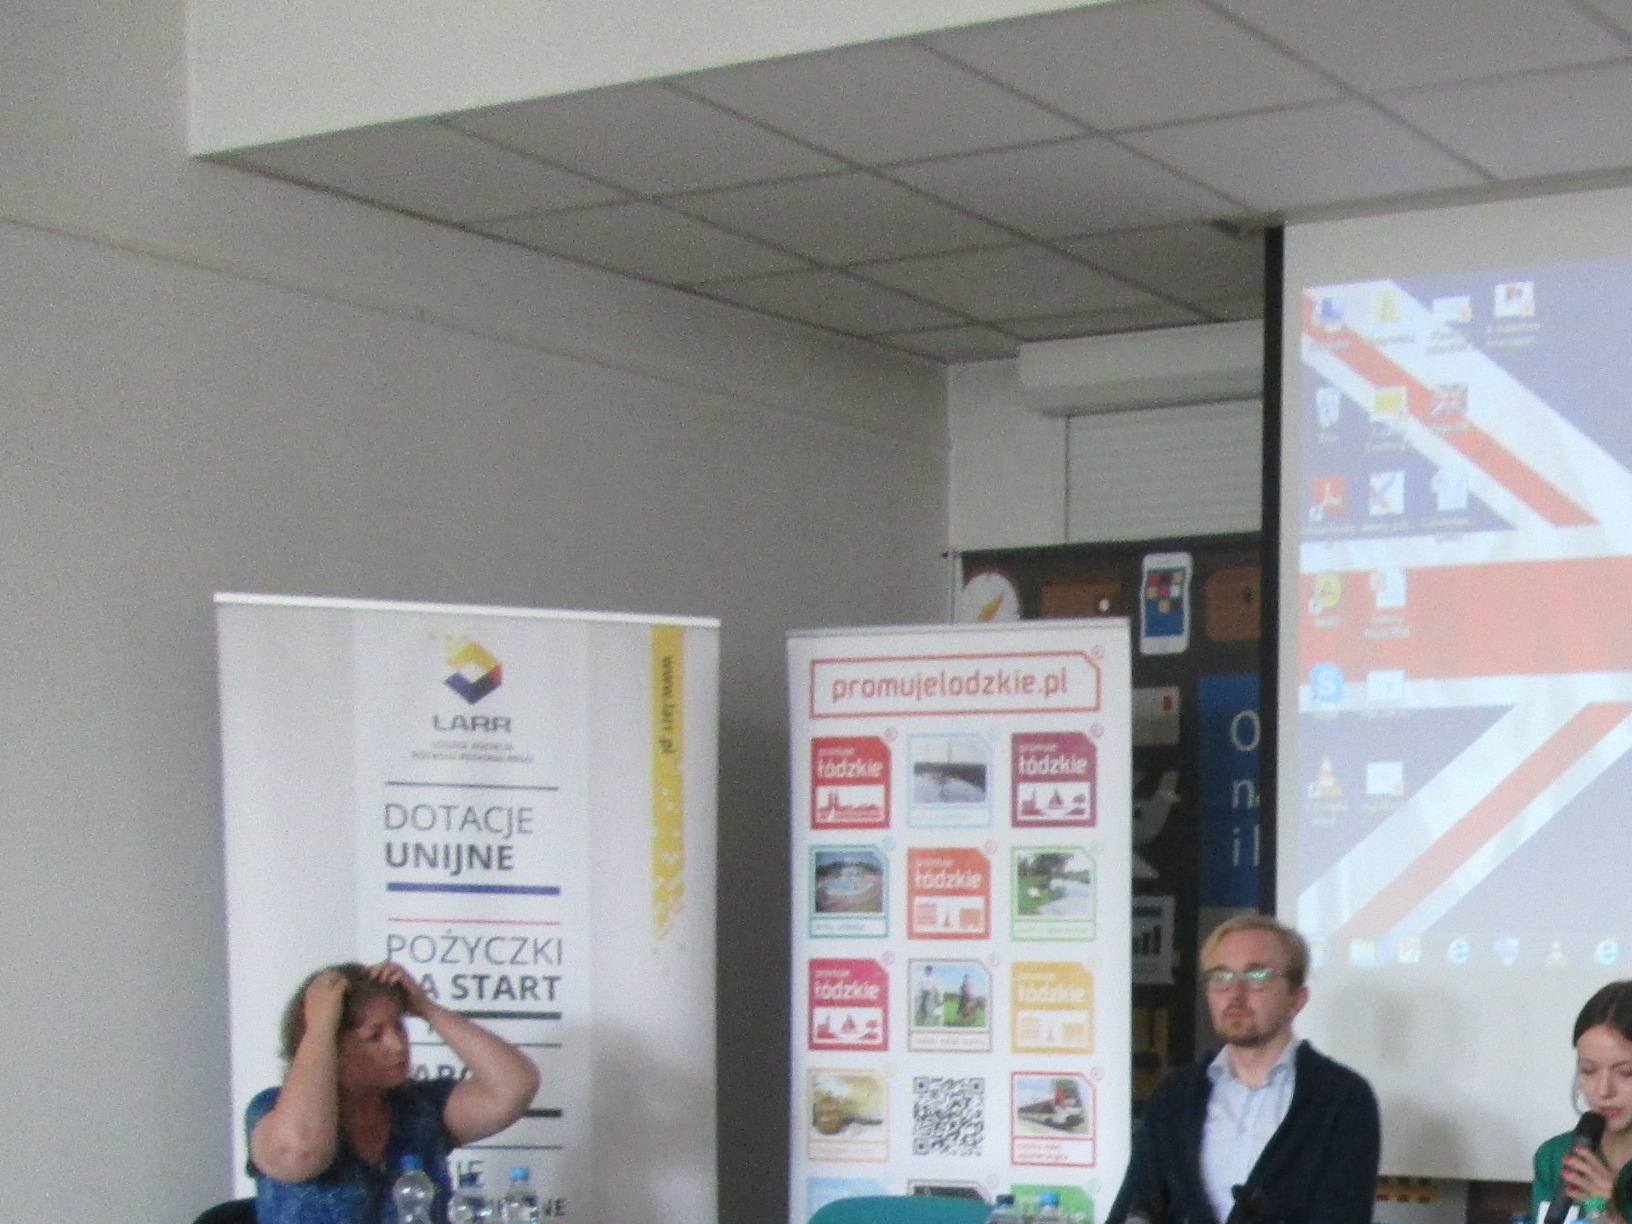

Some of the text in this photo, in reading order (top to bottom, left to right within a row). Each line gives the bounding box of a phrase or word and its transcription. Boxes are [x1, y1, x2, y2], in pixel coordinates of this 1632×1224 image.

[832, 667, 1068, 704] promujelodzkie.pl
[384, 803, 534, 839] DOTACJE
[385, 841, 515, 876] UNIJNE
[387, 928, 562, 966] POŻYCZKI
[451, 973, 562, 1001] START
